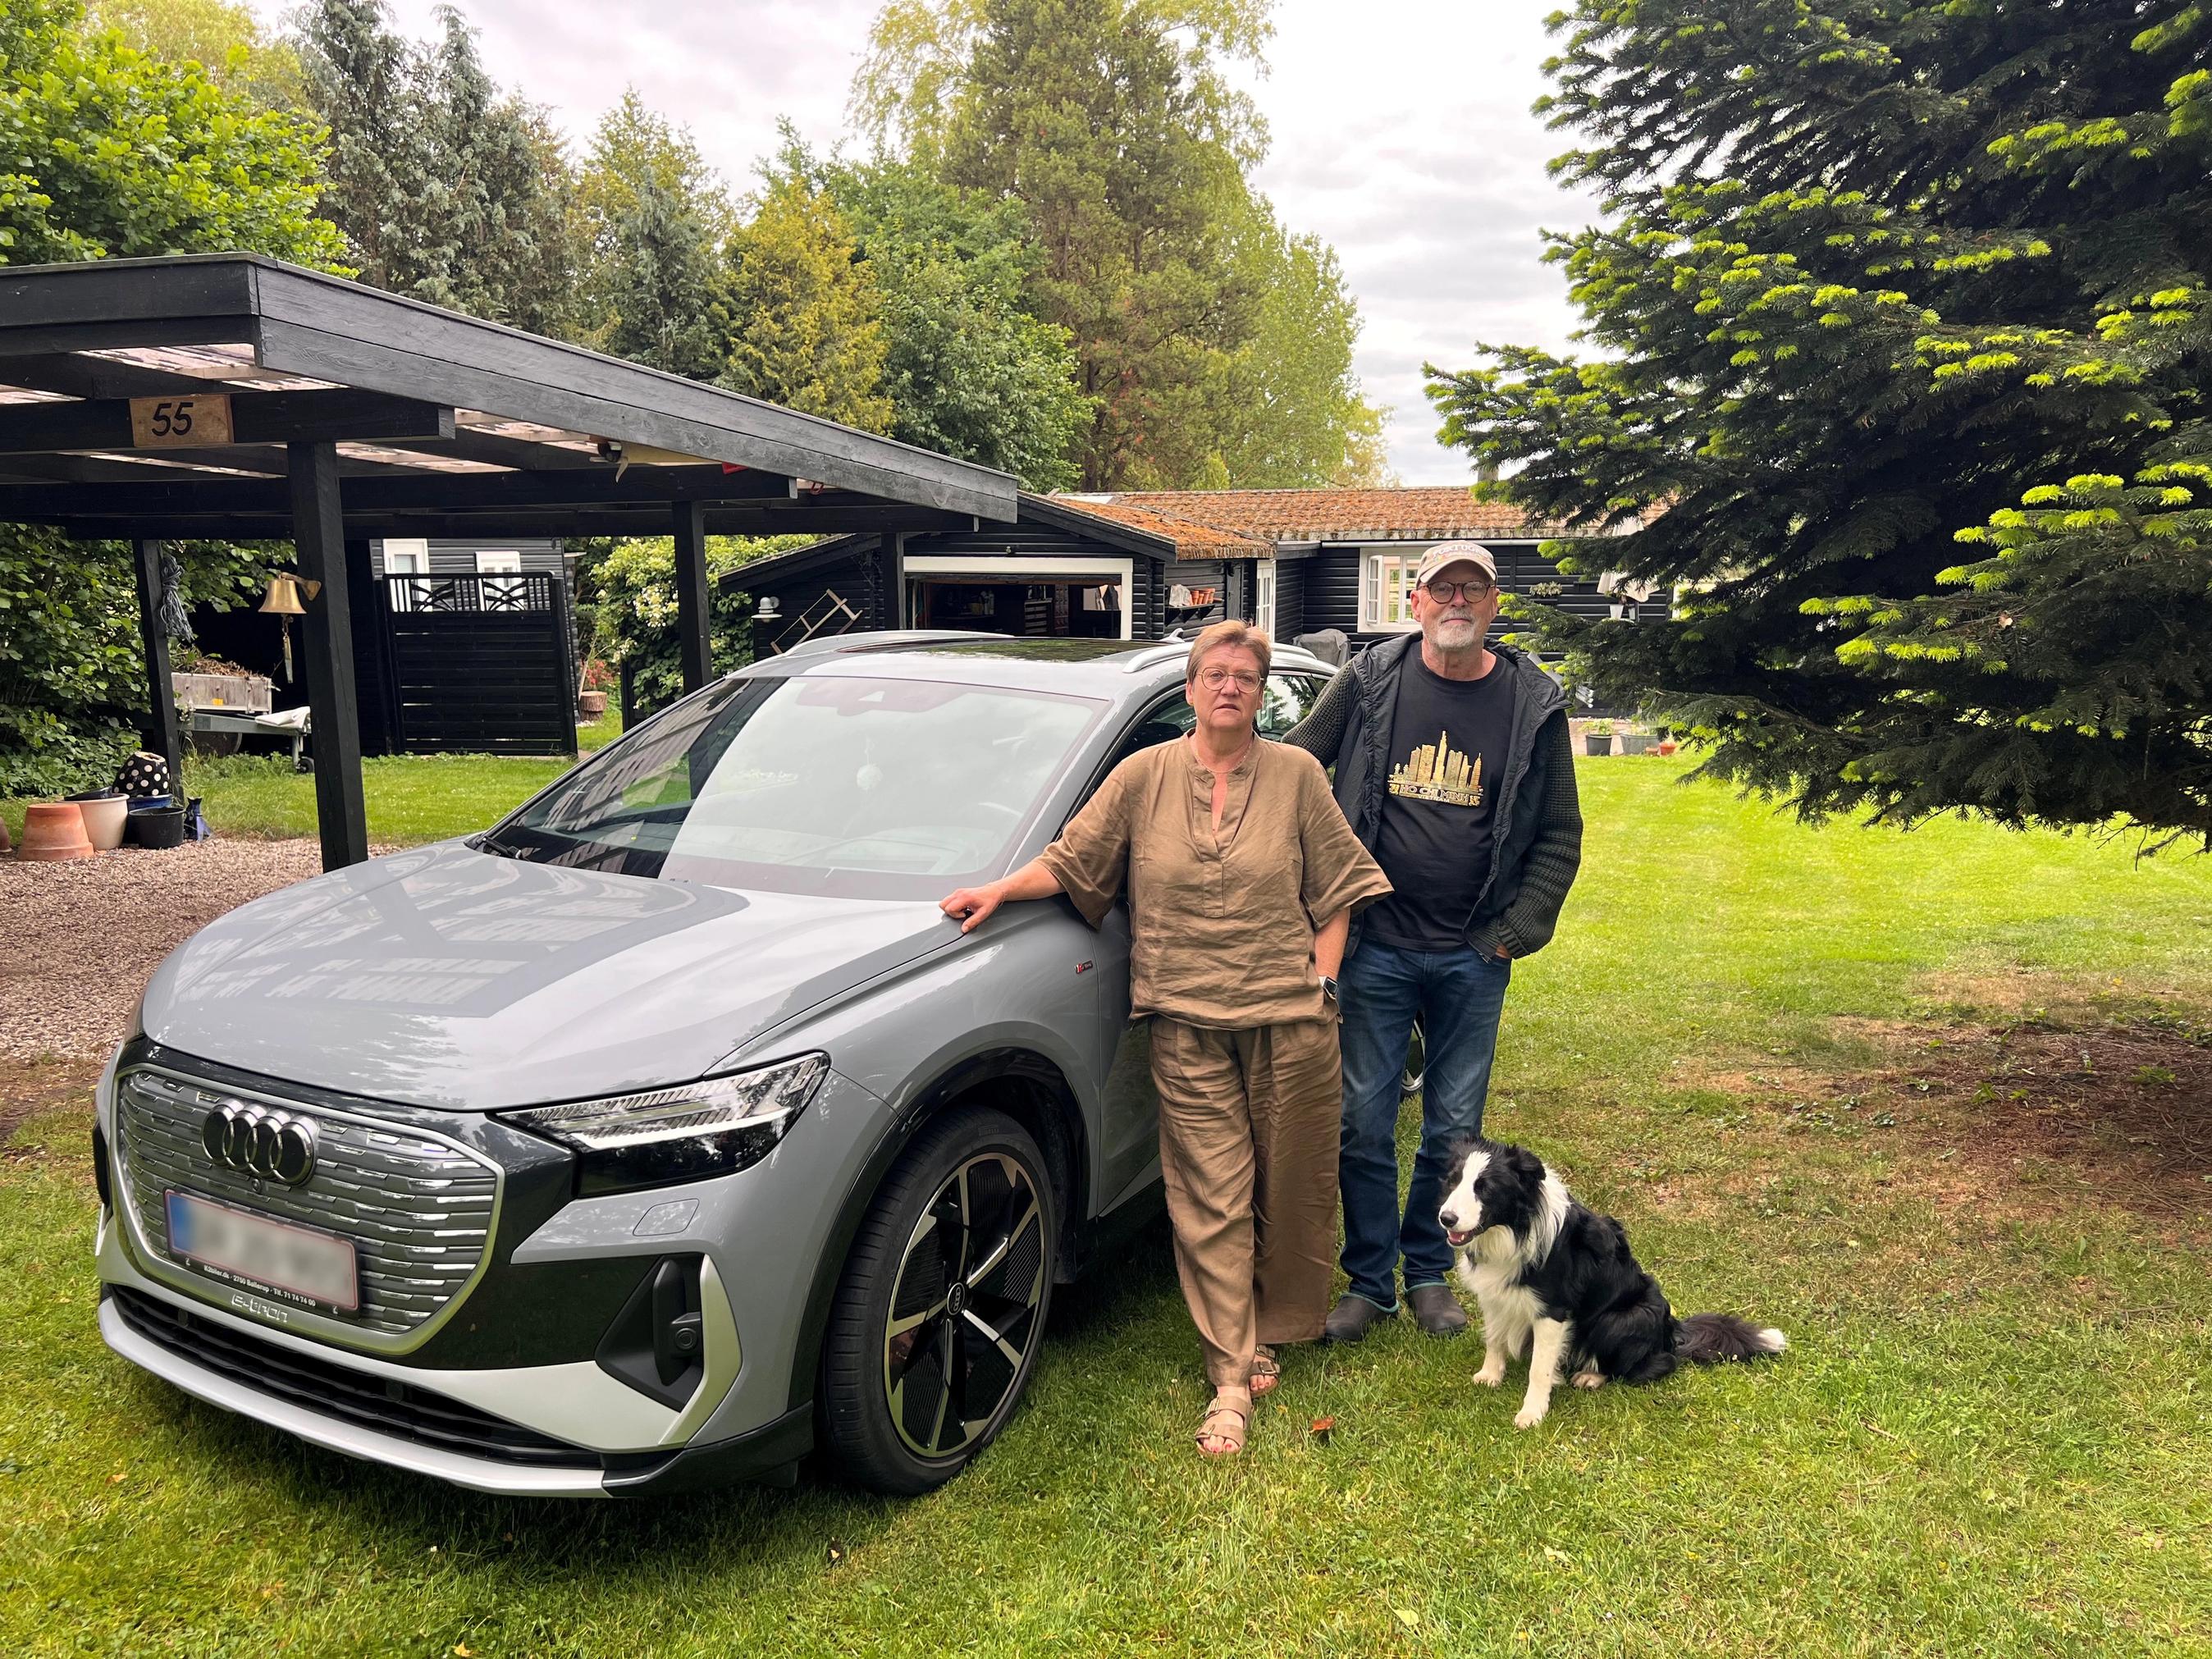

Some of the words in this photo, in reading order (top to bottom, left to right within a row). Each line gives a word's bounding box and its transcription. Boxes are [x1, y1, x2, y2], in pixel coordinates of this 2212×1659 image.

[152, 402, 194, 436] 55
[1400, 784, 1417, 794] HO
[1419, 787, 1439, 798] CHI
[1440, 789, 1469, 802] MINH
[284, 1291, 290, 1299] 71
[308, 1298, 316, 1307] 00
